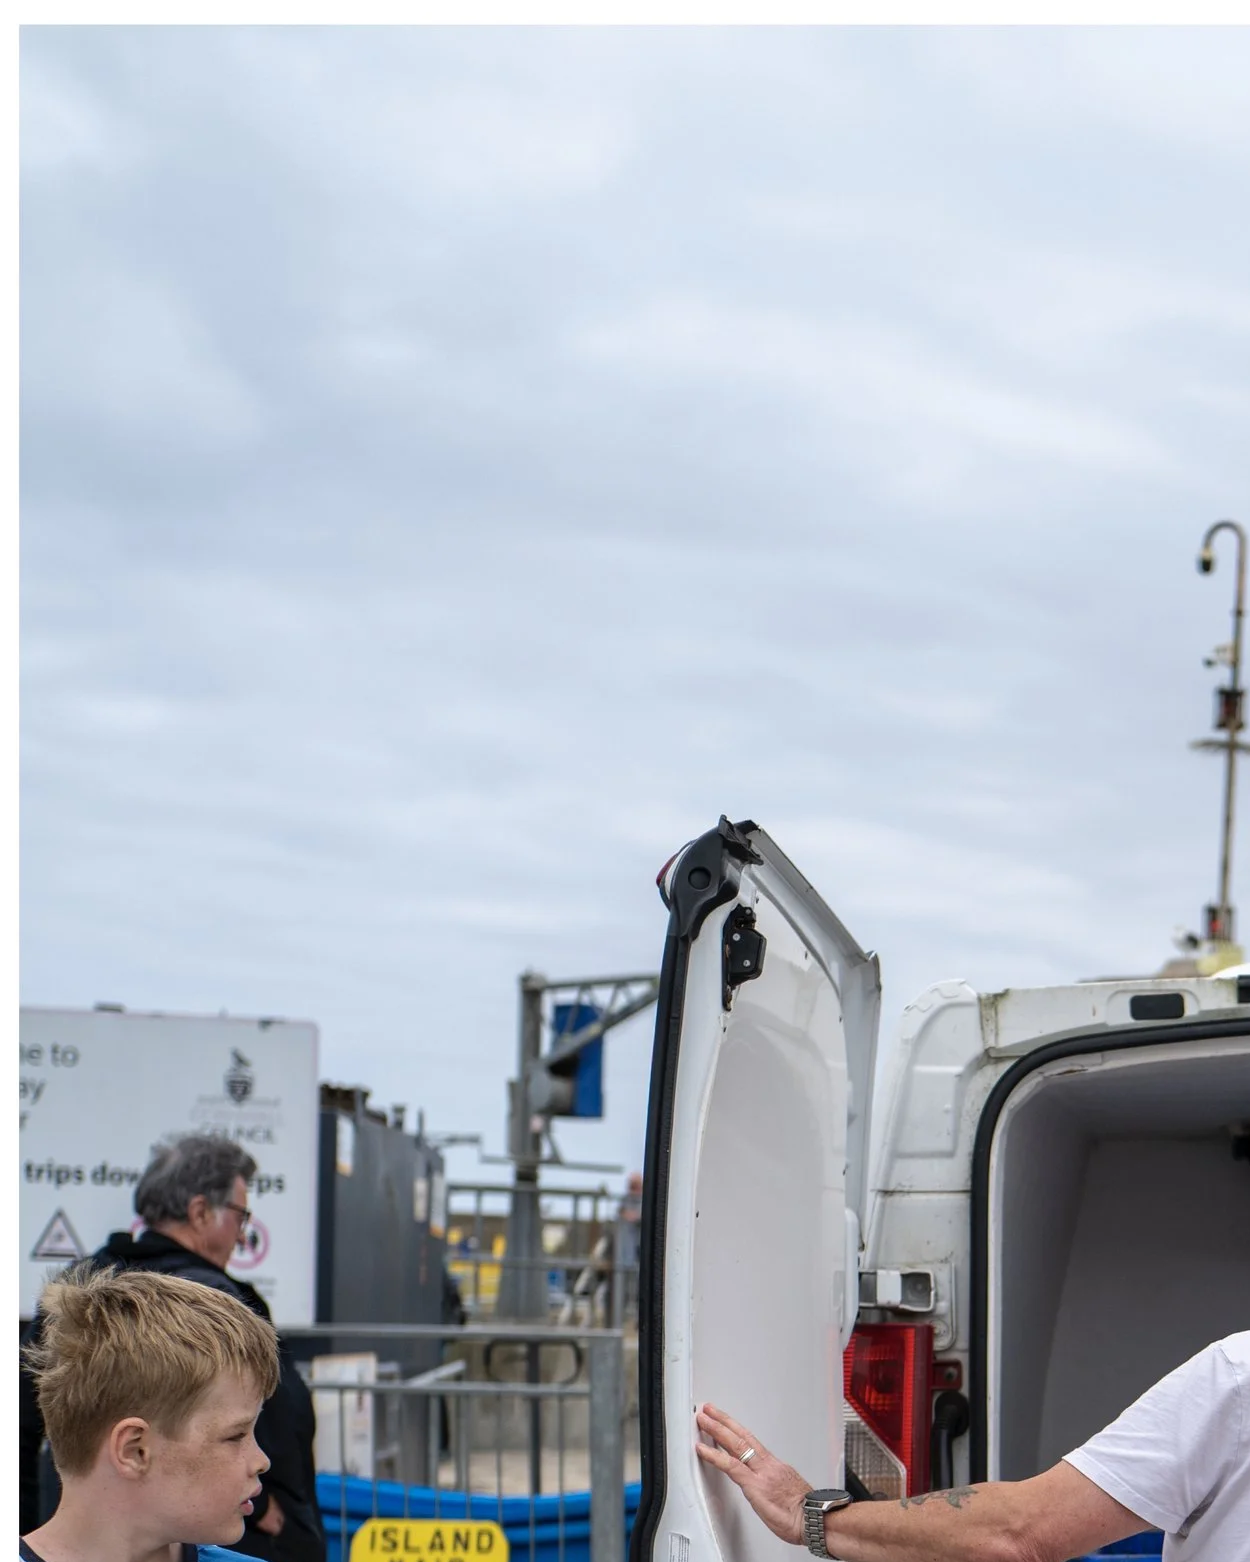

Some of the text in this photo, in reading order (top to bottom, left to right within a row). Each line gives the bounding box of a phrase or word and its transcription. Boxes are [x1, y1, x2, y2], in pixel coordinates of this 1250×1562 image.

[51, 1042, 80, 1068] to
[25, 1158, 85, 1189] trips
[370, 1527, 494, 1554] ISLAND
